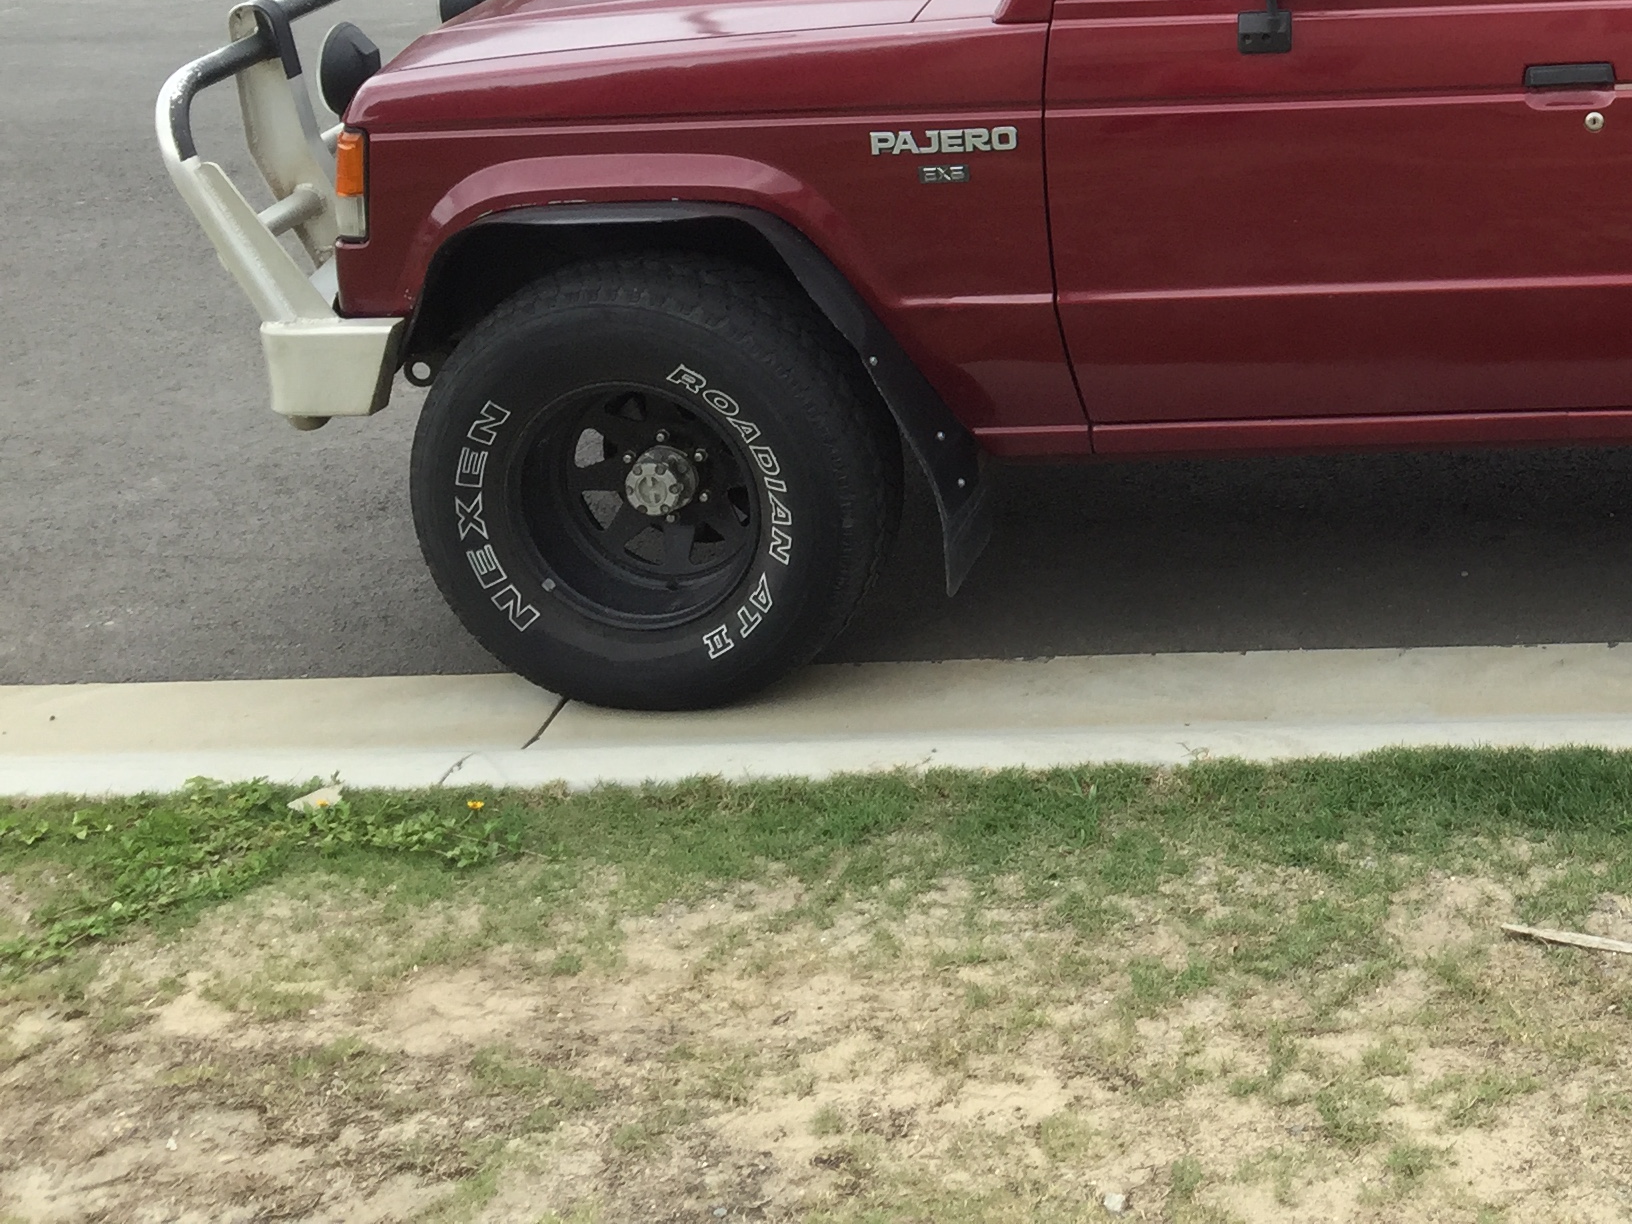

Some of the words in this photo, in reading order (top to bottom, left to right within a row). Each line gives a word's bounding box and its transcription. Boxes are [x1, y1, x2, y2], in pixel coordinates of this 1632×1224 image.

[869, 126, 1018, 156] PAJERO
[454, 400, 541, 633] NEXEN
[666, 363, 793, 565] ROADIAN
[736, 572, 775, 639] AT
